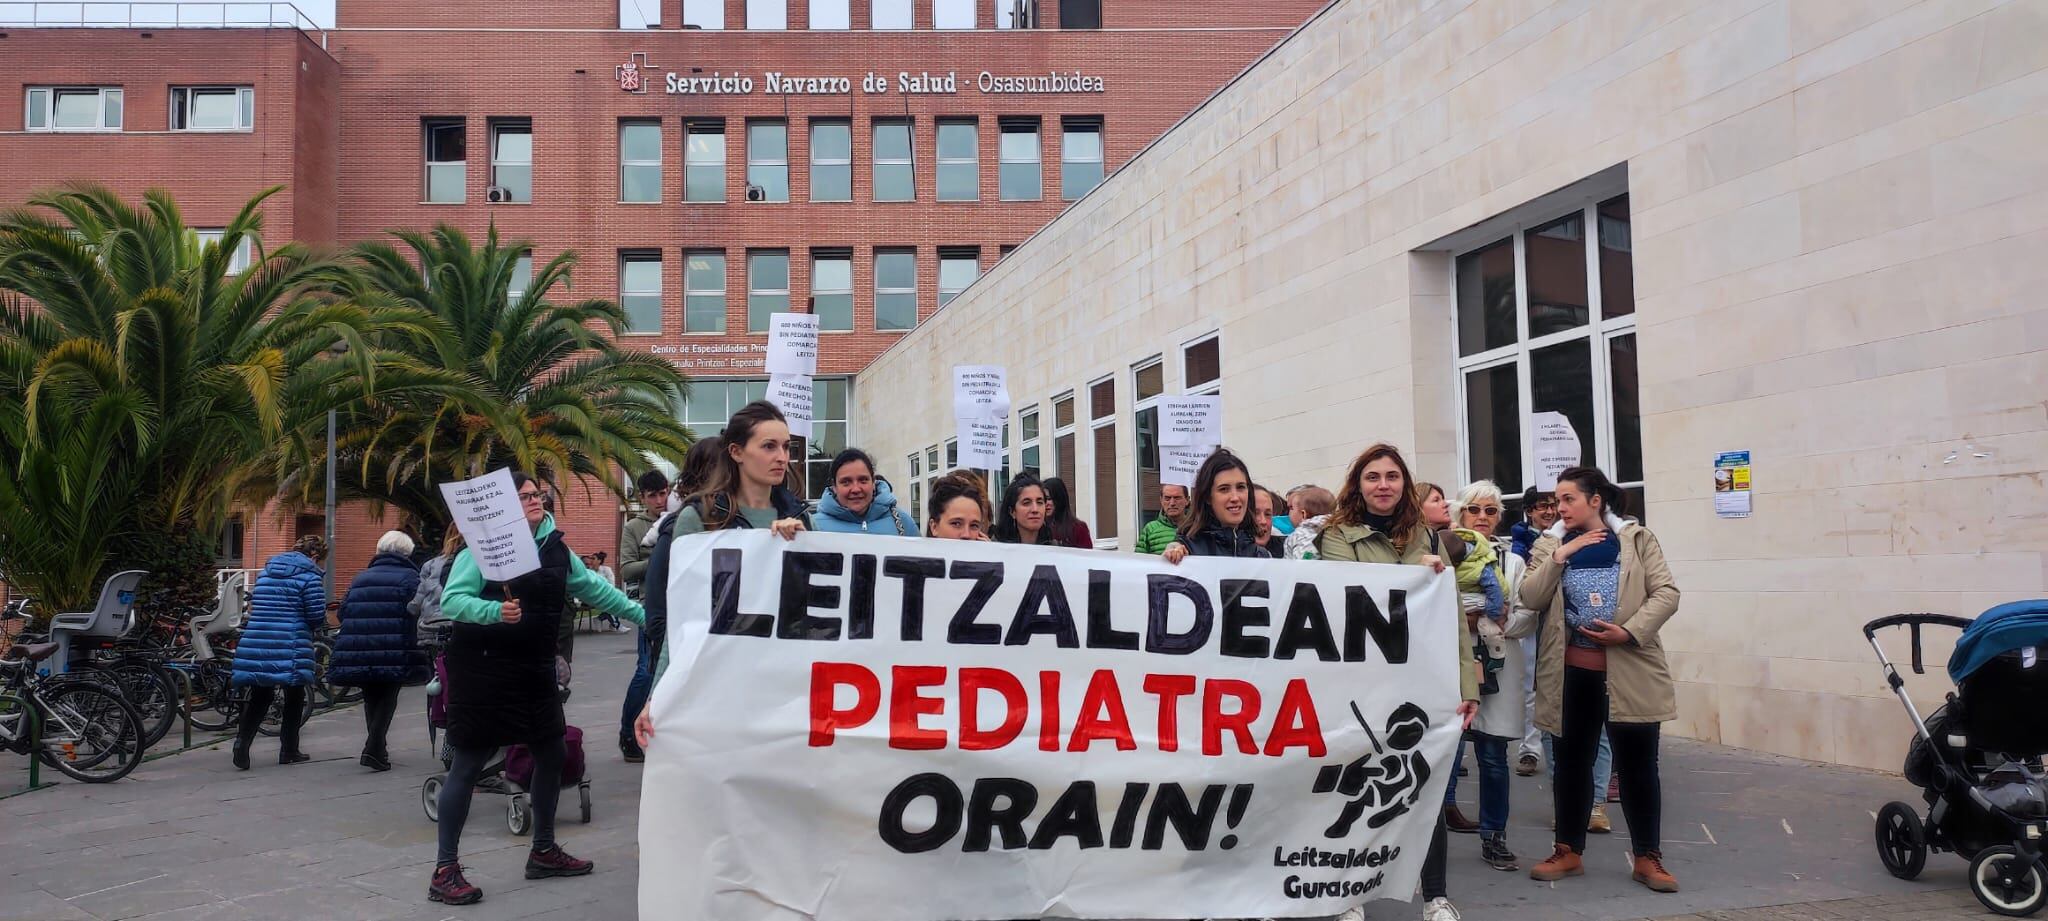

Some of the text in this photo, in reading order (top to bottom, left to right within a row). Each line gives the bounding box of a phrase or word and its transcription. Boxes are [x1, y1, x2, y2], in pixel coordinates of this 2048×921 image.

[666, 71, 1105, 94] Servicio Navarro de Salud Osasunbidea
[651, 343, 769, 355] Centro de Especialidades Princ
[708, 547, 1409, 664] LEITZALDEAN
[808, 660, 1327, 758] PEDIATRA
[877, 771, 1254, 853] ORAIN!
[1274, 845, 1401, 868] Leitzaldeko
[1283, 870, 1384, 899] Gurasoak
